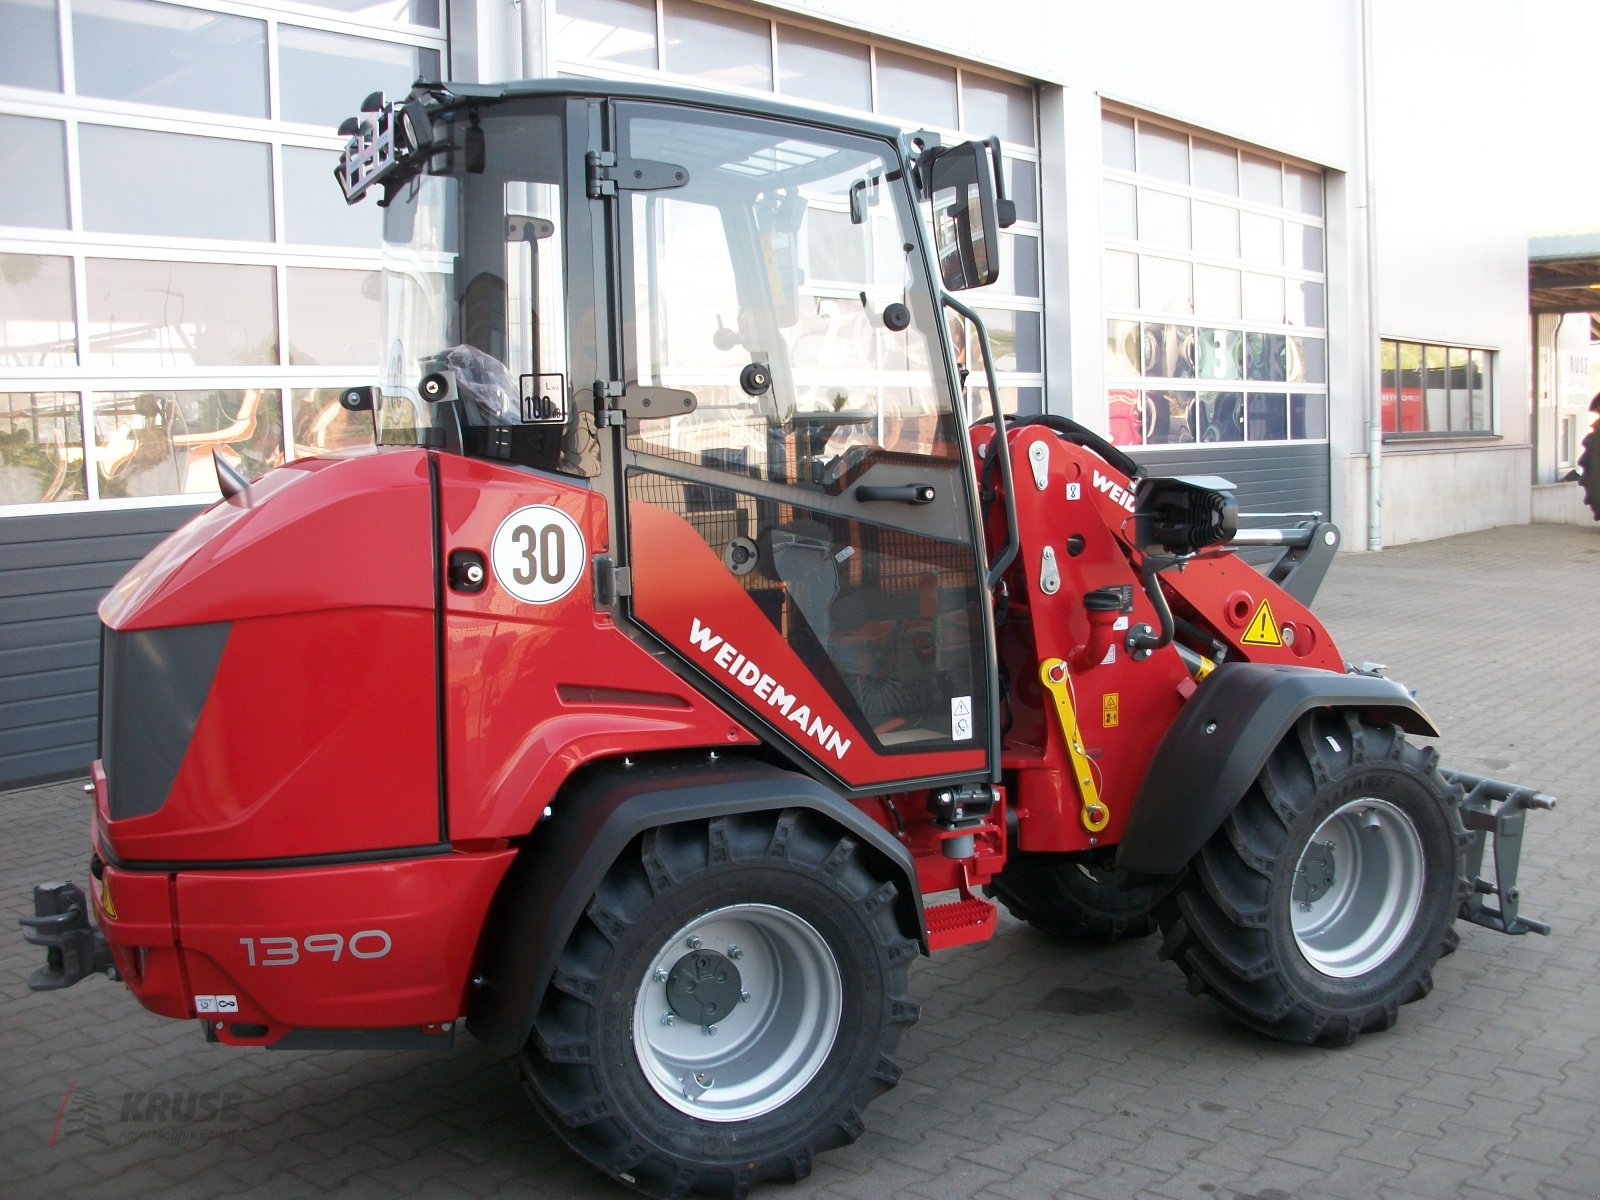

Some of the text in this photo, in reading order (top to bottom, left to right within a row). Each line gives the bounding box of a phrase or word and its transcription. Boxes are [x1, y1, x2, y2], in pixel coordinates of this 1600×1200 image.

[525, 395, 551, 419] 100
[511, 523, 566, 586] 30
[689, 617, 852, 760] WEIDEMANN
[239, 929, 392, 967] 1390
